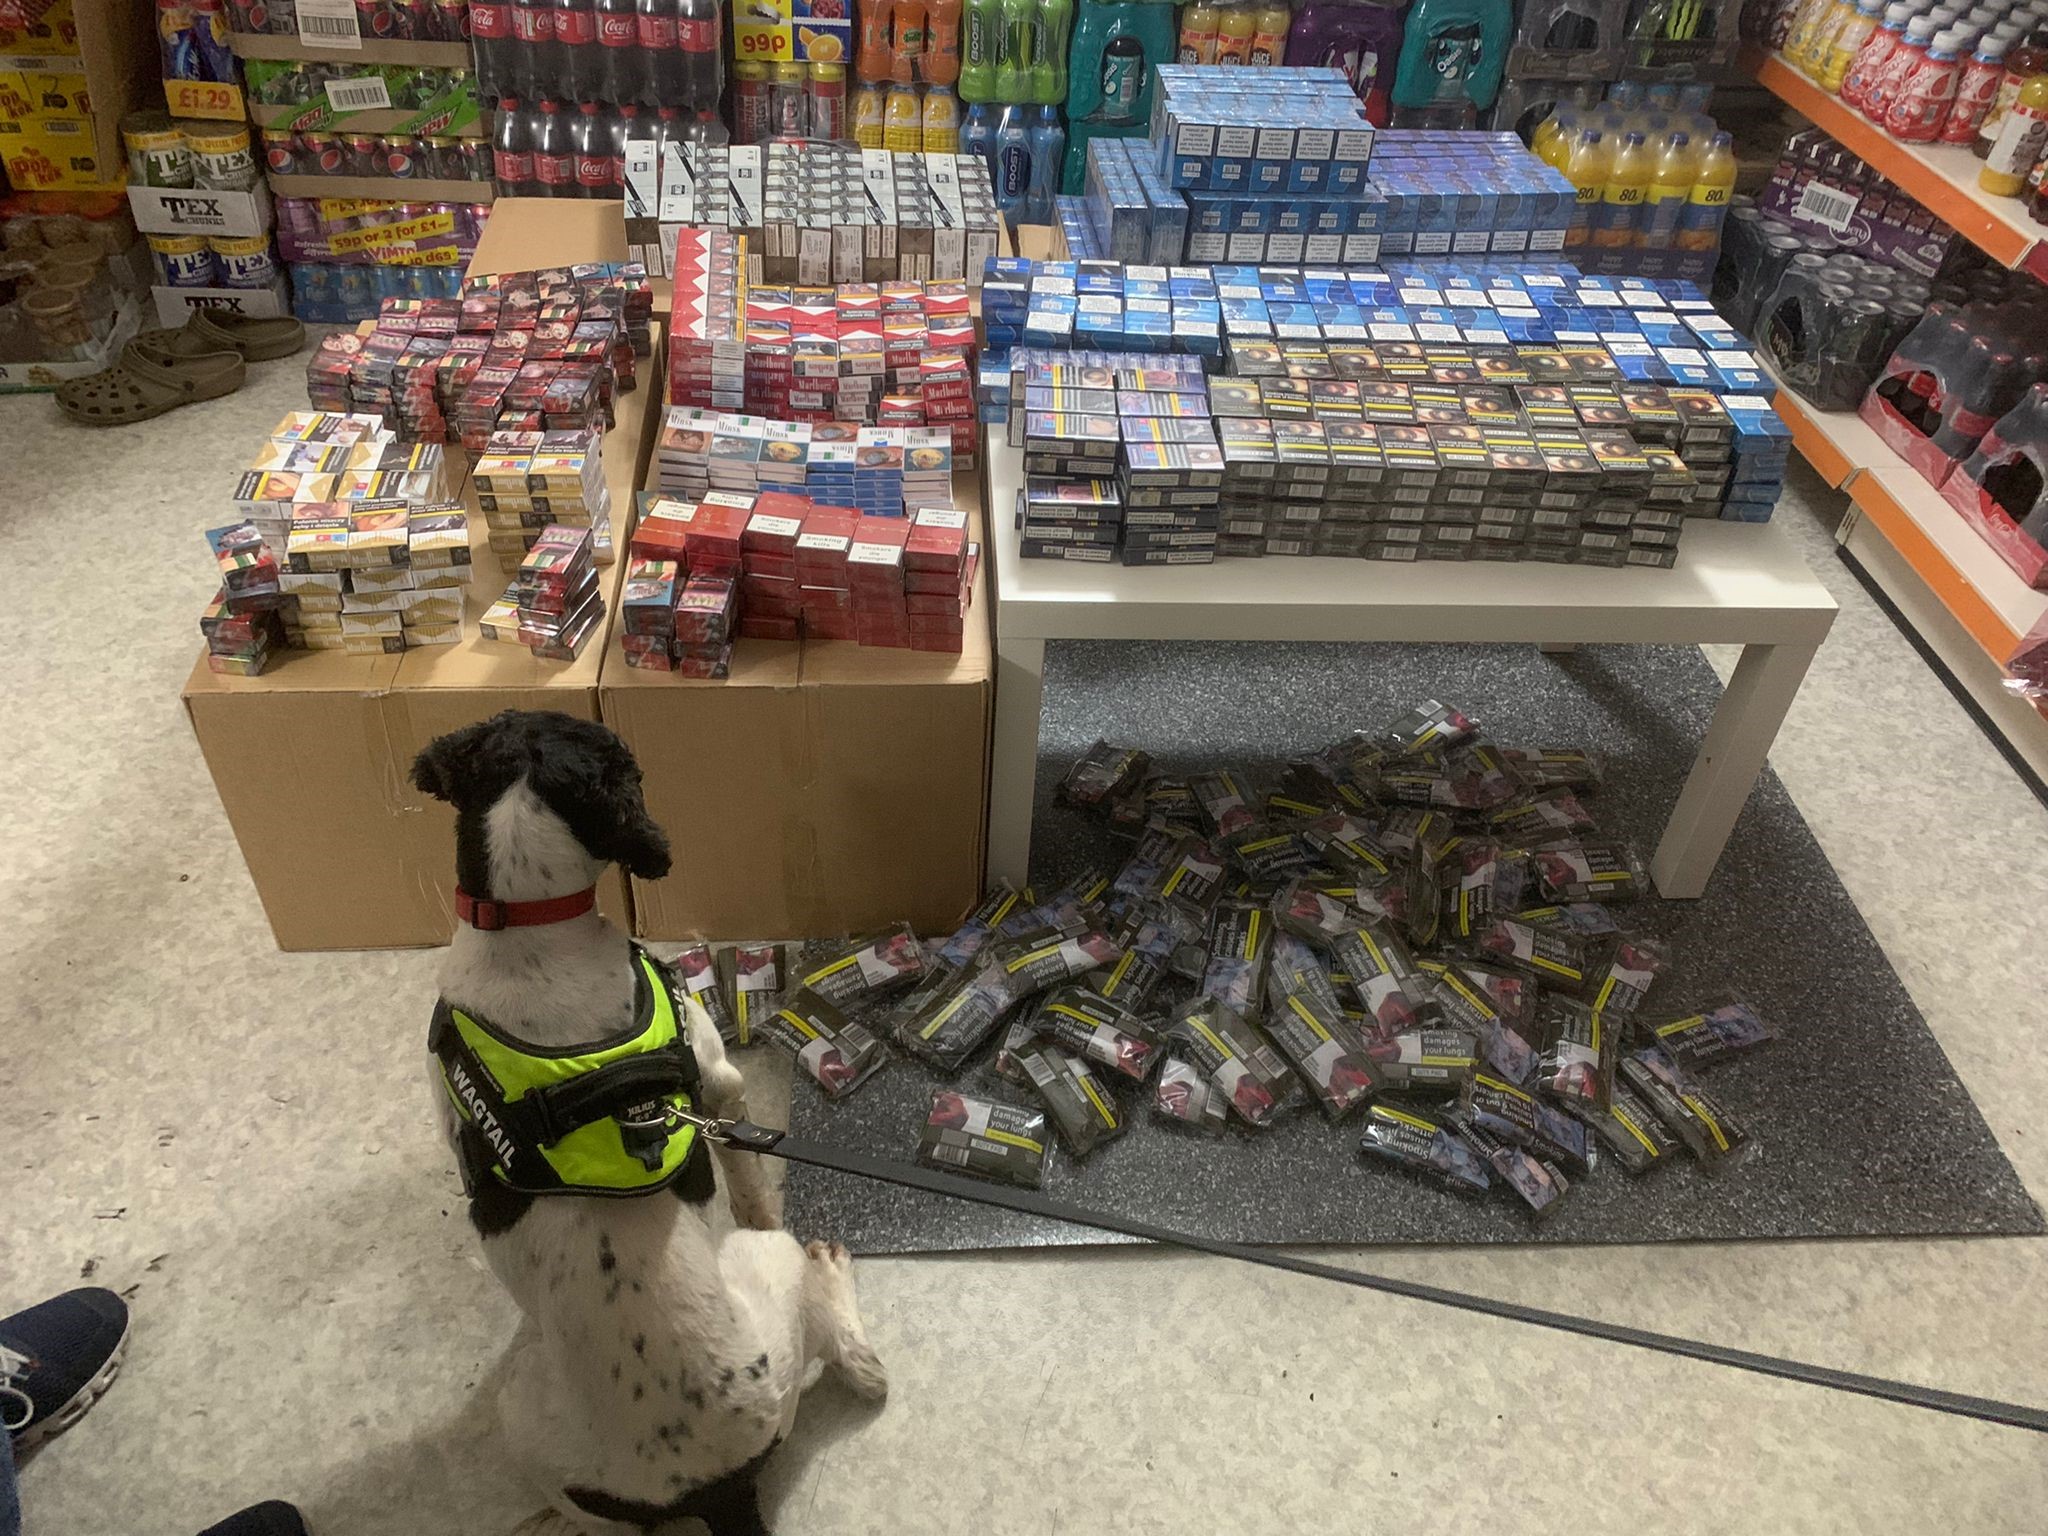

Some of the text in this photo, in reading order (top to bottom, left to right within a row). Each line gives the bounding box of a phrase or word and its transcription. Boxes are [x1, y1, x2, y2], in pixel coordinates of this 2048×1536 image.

[742, 32, 786, 54] 99p
[970, 14, 980, 61] BOOST
[178, 87, 232, 111] £1.29
[1006, 145, 1020, 192] BOOST
[160, 196, 224, 223] TEX
[335, 219, 438, 251] 59p or 2 for £1
[168, 249, 211, 279] TE
[670, 414, 694, 428] Minsk
[718, 419, 742, 433] Minsk
[765, 426, 790, 441] Minsk
[1423, 1036, 1461, 1047] damages
[1424, 1046, 1466, 1058] your lungs
[453, 1063, 516, 1169] WAGTAIL
[627, 1100, 656, 1118] JULIUS
[993, 1109, 1029, 1125] damages
[990, 1120, 1032, 1138] your lungs
[1399, 1121, 1434, 1139] attacks
[1457, 1120, 1494, 1158] Smoking
[1387, 1135, 1429, 1160] Smoking
[1399, 1131, 1432, 1148] causes
